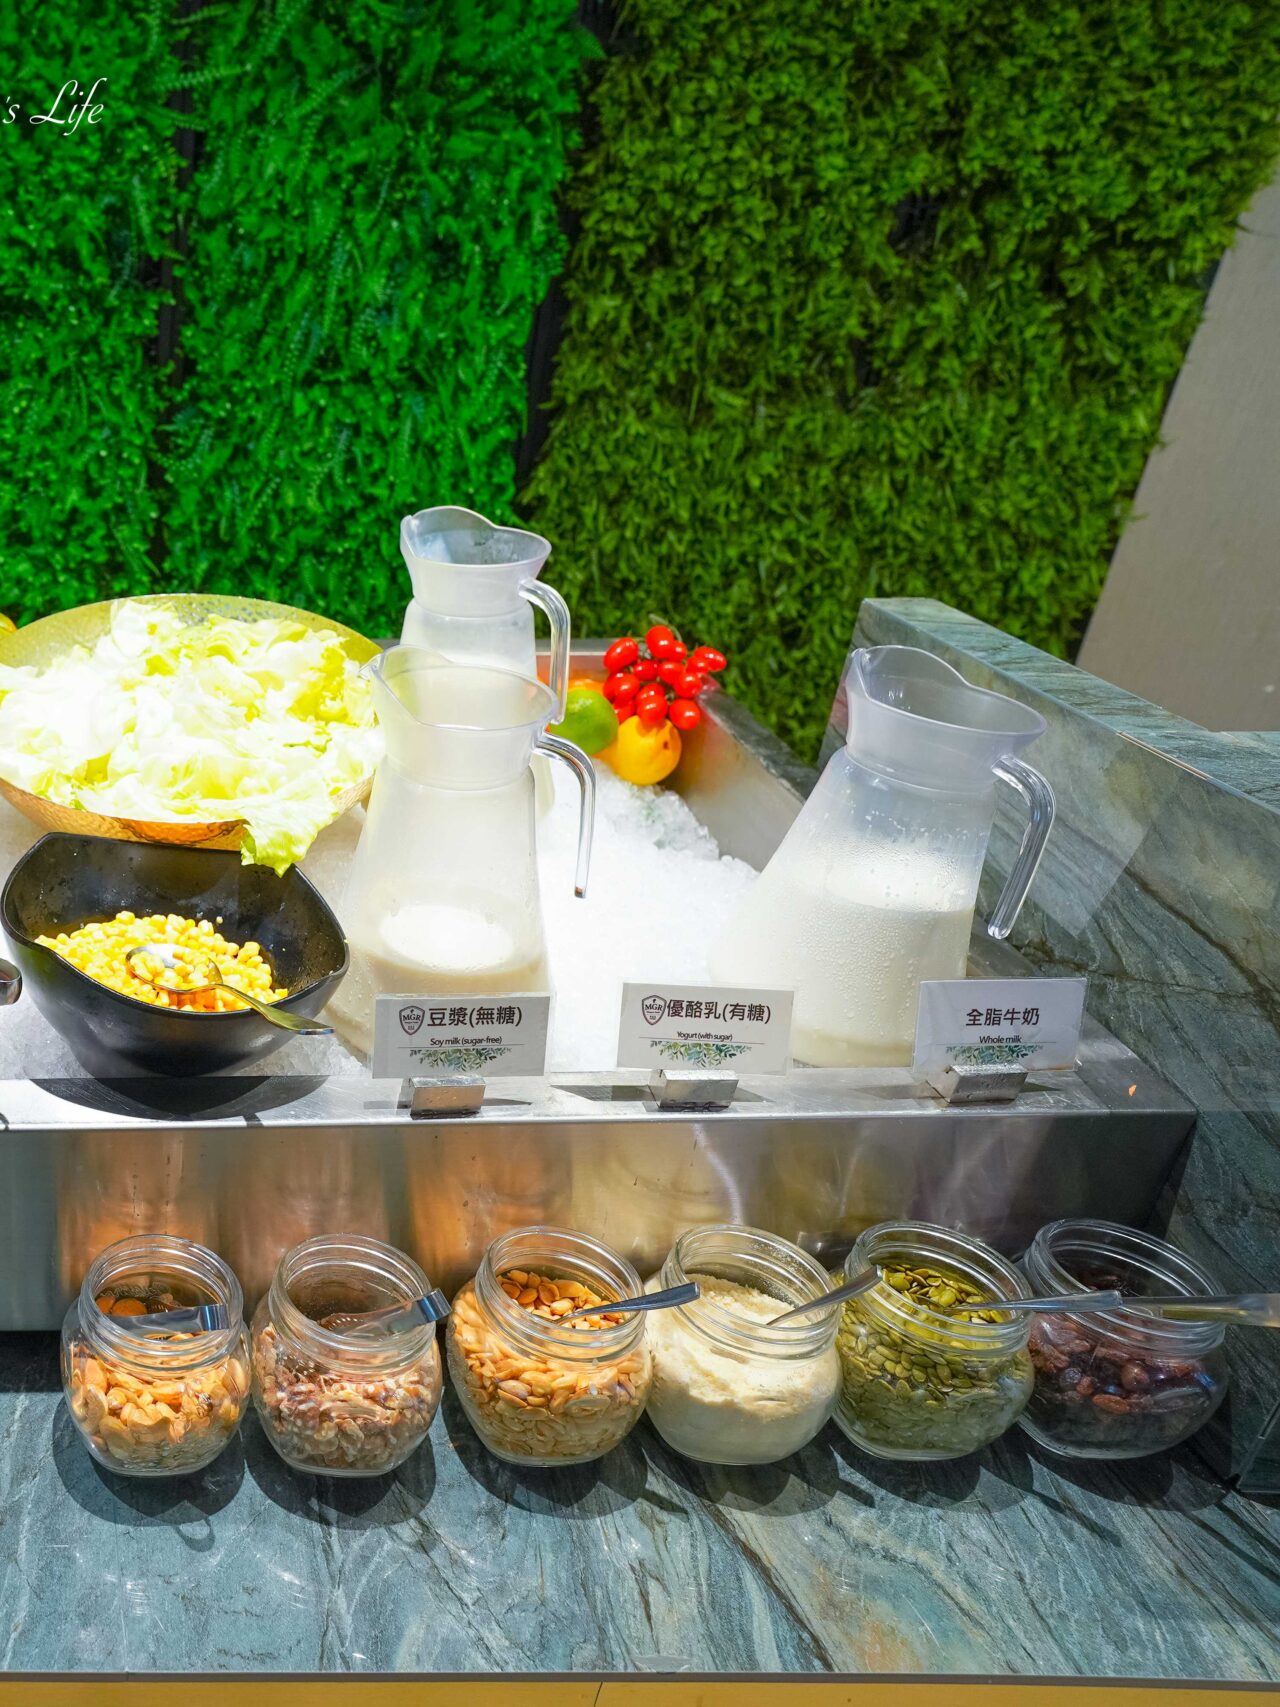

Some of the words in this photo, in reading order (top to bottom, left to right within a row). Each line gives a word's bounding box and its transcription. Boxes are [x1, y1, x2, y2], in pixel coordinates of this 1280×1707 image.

[644, 1003, 663, 1011] MGR
[667, 999, 771, 1024] 優酪乳(有糖)
[427, 1005, 523, 1028] 豆漿(無糖)
[965, 1007, 1040, 1026] 全脂牛奶
[430, 1038, 444, 1048] Soy
[444, 1037, 460, 1046] milk
[461, 1035, 503, 1046] (sugar-free)
[676, 1031, 698, 1040] Yogurt
[697, 1032, 714, 1040] (with
[713, 1033, 733, 1043] sugar)
[979, 1035, 1005, 1044] Whole
[1005, 1035, 1022, 1044] milk
